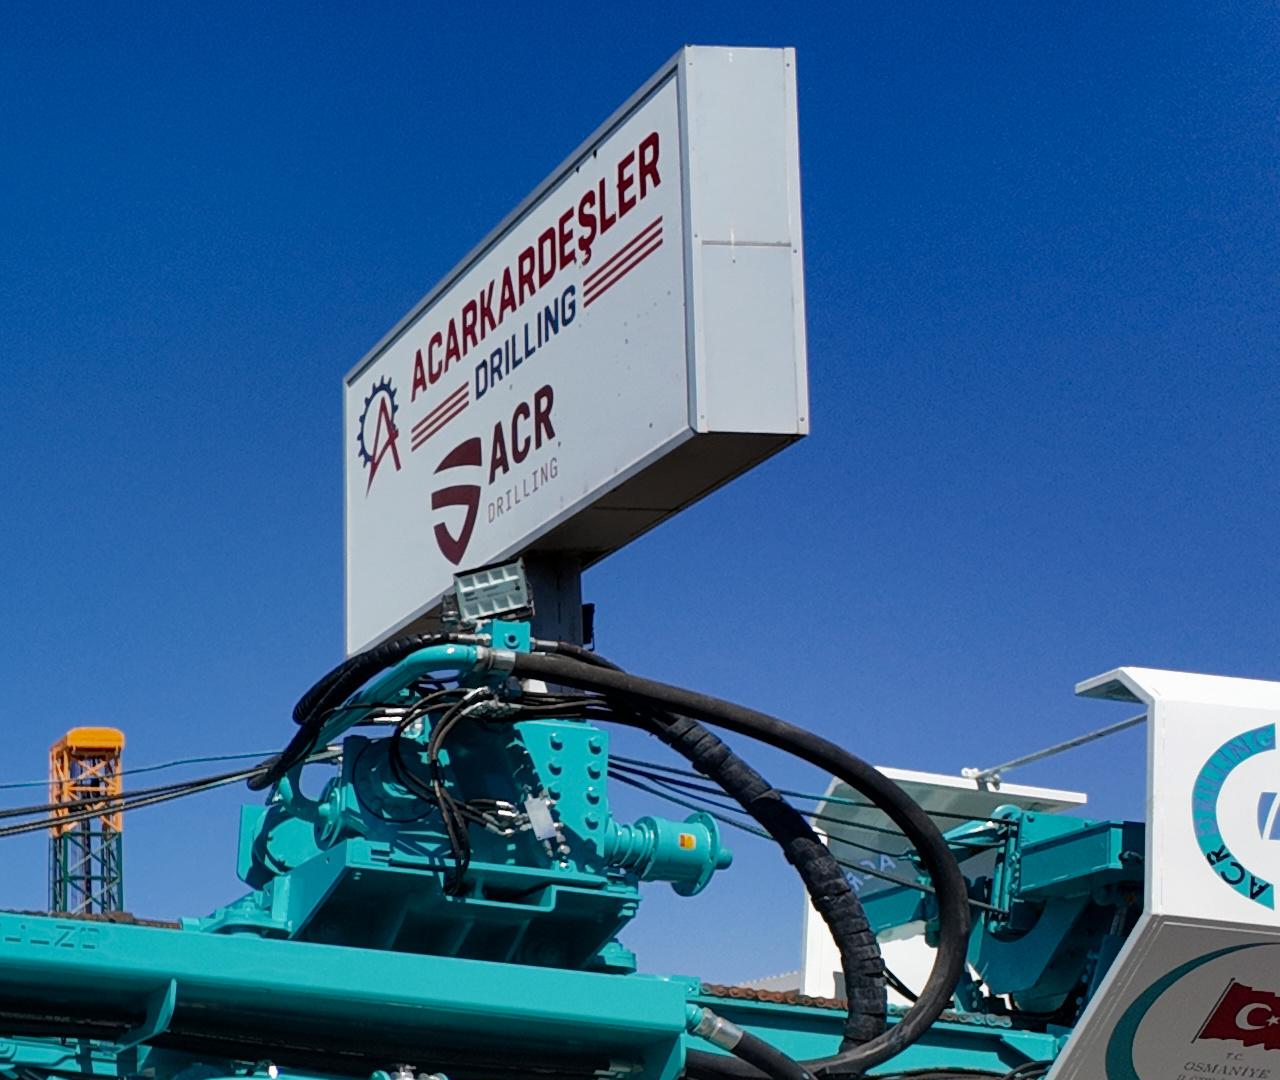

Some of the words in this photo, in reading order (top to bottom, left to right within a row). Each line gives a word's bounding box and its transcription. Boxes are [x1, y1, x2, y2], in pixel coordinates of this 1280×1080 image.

[411, 131, 661, 402] ACARKARDEŞLER
[475, 285, 576, 400] DRILLING
[489, 384, 555, 485] ACR
[488, 457, 558, 523] DRILLING
[1207, 844, 1270, 900] ACR
